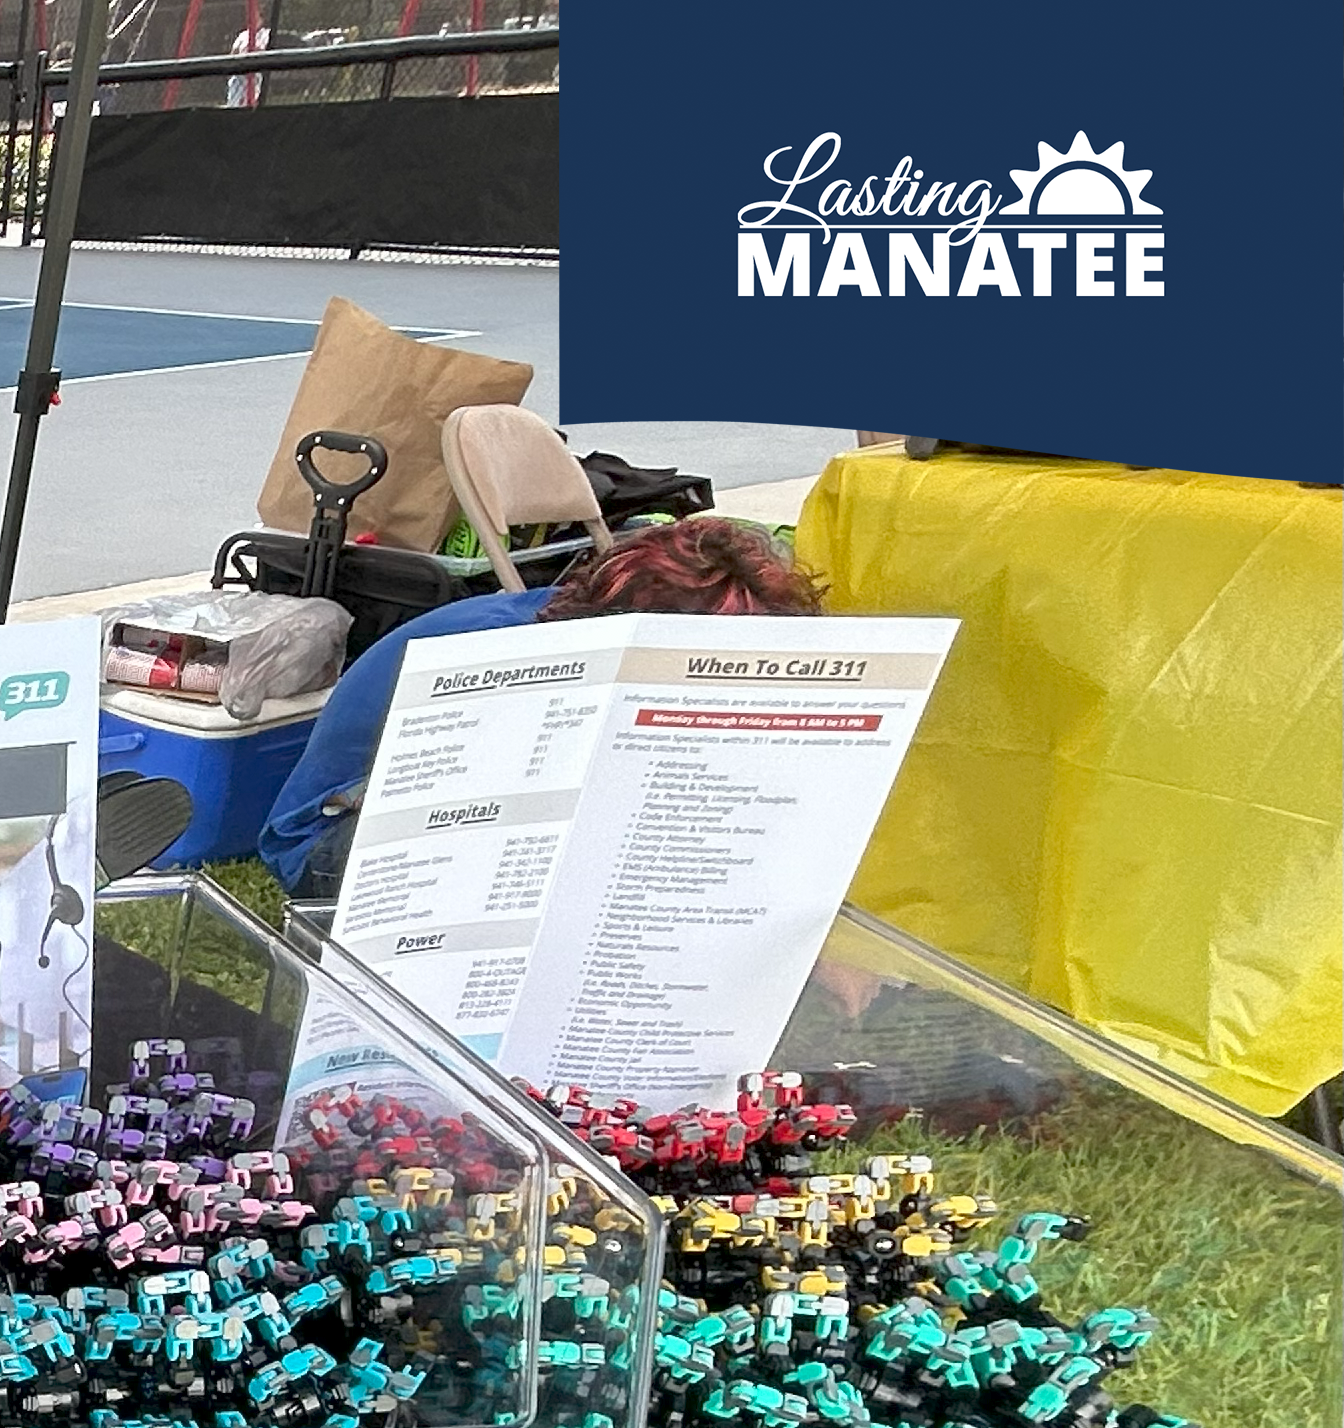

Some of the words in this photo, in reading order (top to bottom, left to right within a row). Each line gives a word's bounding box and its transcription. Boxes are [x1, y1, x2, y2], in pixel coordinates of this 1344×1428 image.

[433, 671, 479, 691] Police
[481, 661, 586, 689] Departments
[687, 657, 749, 674] When
[756, 659, 779, 675] To
[786, 659, 827, 676] Call
[829, 661, 867, 676] 311
[5, 677, 59, 706] 311
[652, 713, 695, 726] Monday
[696, 715, 737, 727] through
[738, 716, 772, 728] Friday
[772, 717, 798, 726] from
[429, 802, 501, 824] Hospitals
[397, 932, 446, 949] Power
[326, 1051, 359, 1069] New
